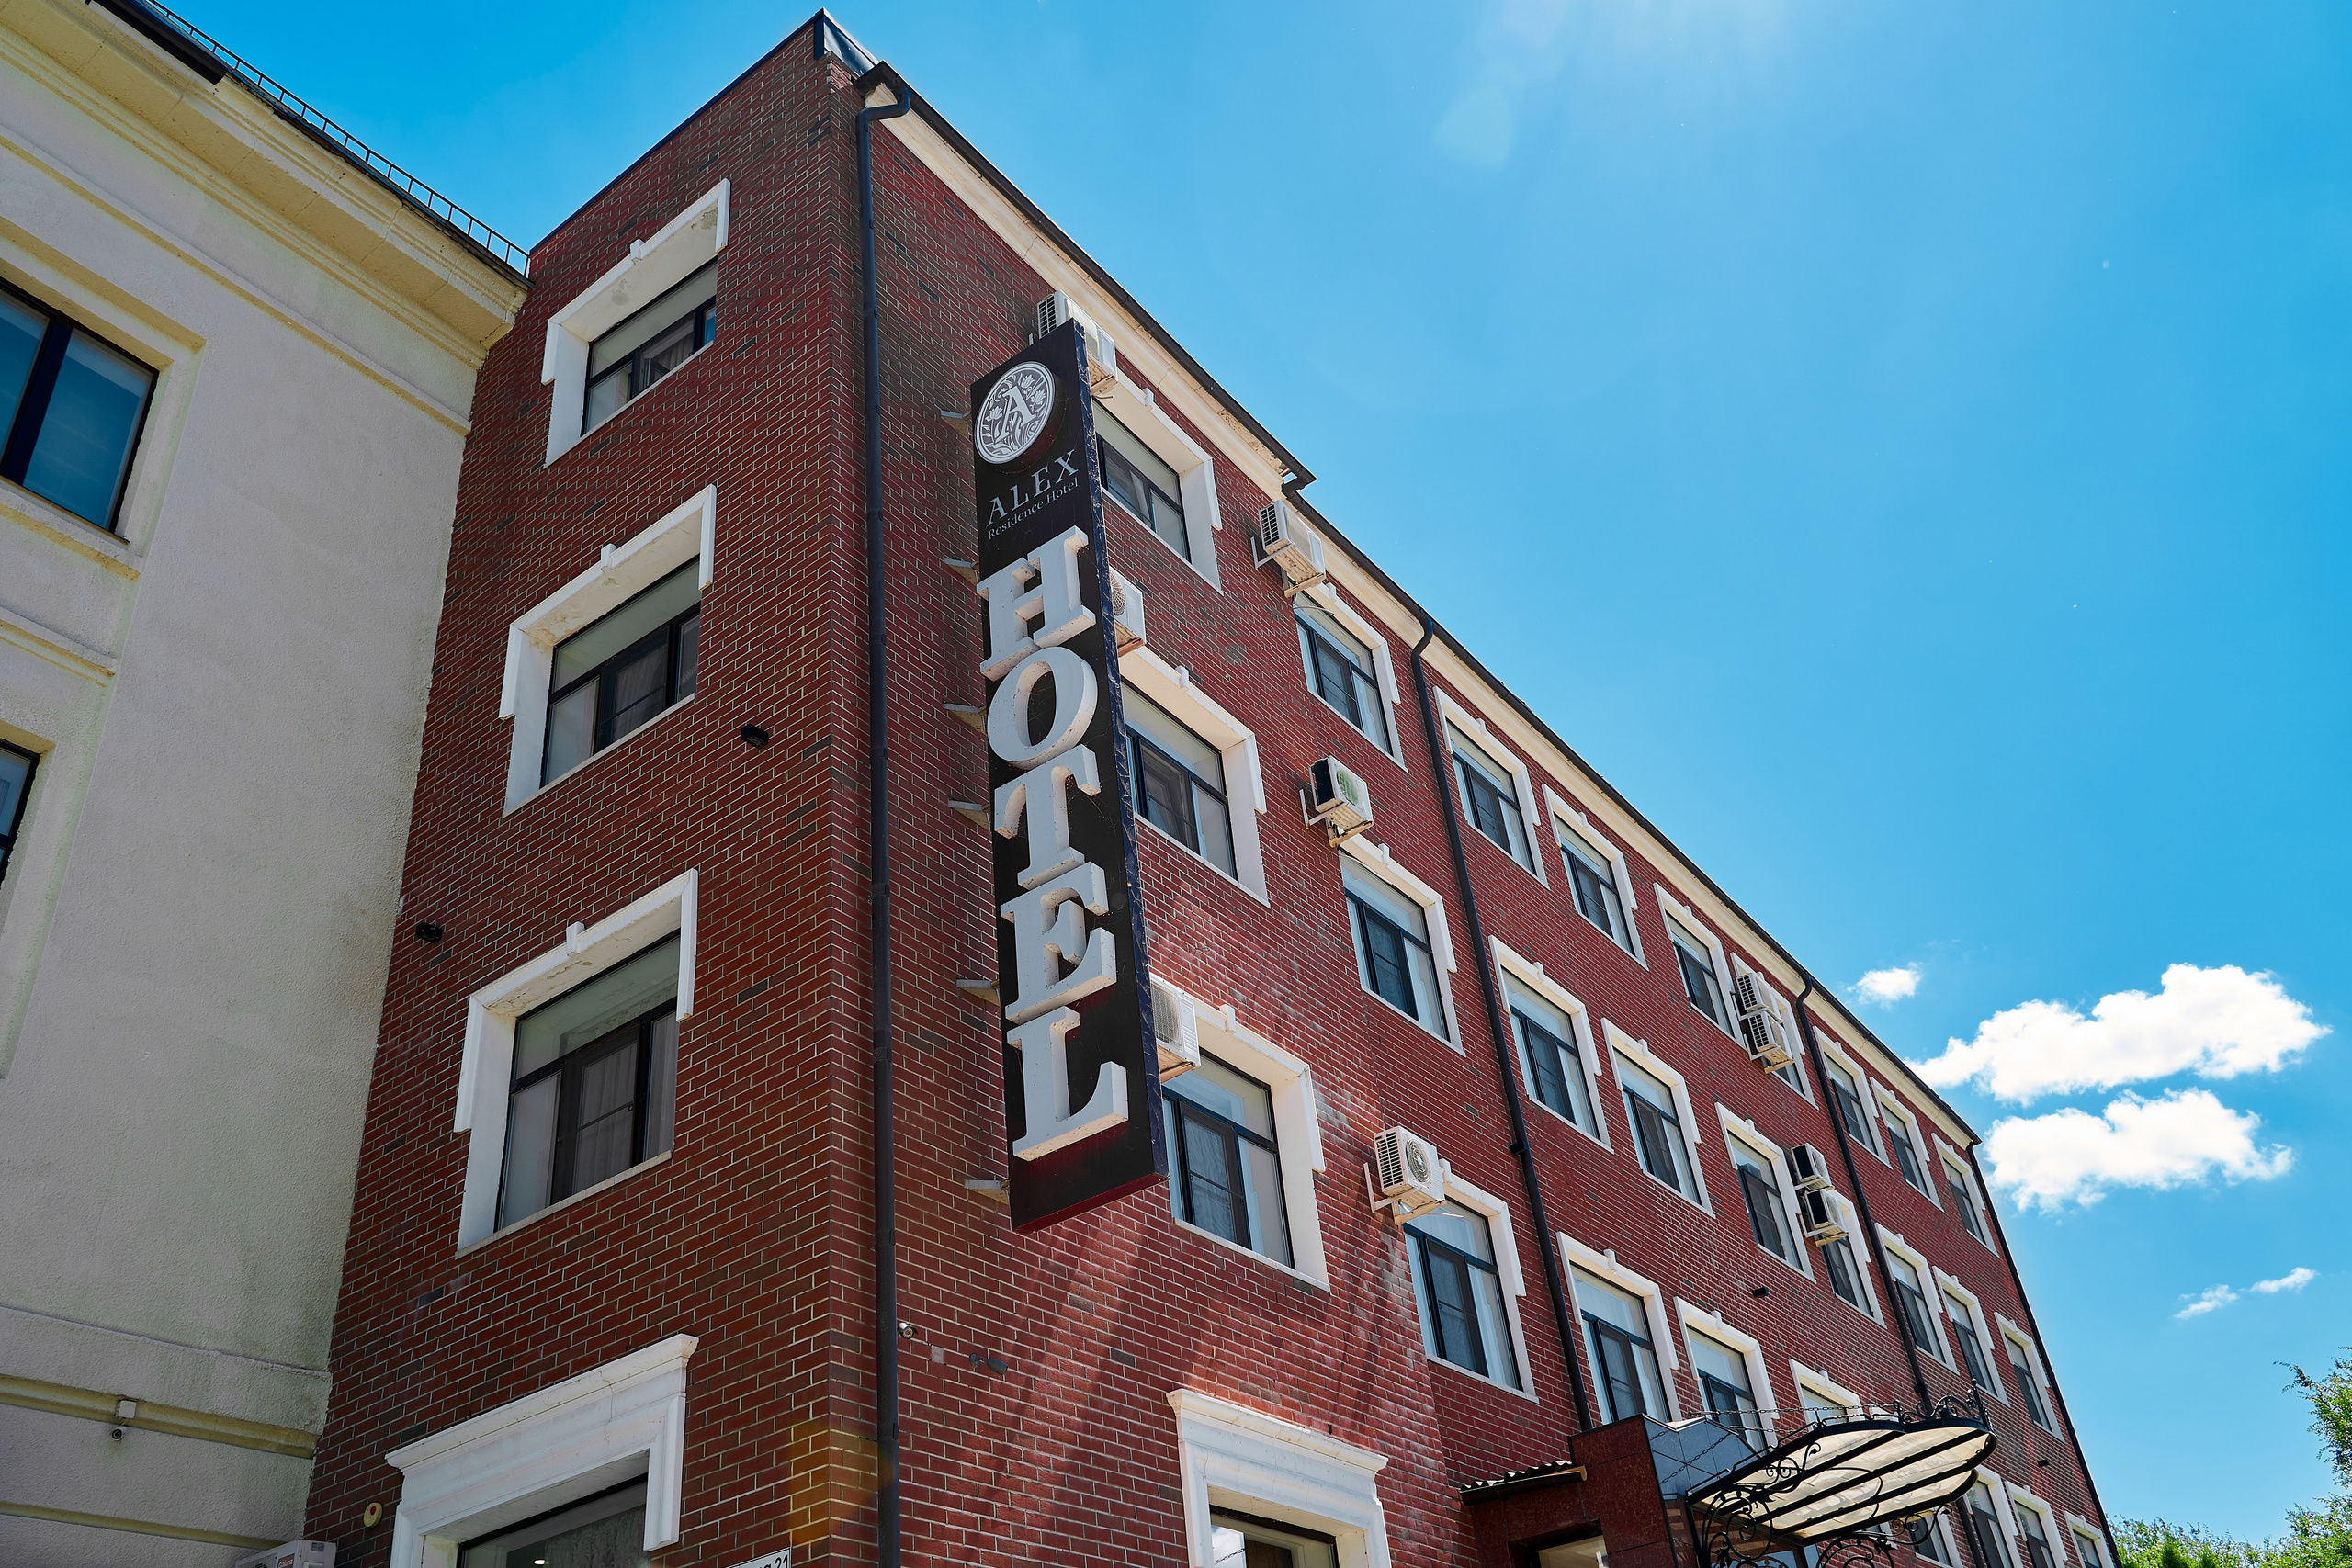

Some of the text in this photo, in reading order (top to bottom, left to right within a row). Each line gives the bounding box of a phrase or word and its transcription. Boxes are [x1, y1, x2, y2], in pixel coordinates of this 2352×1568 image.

[986, 448, 1079, 527] ALEX
[988, 477, 1079, 540] Residence Hotel
[975, 525, 1128, 1163] HOTEL
